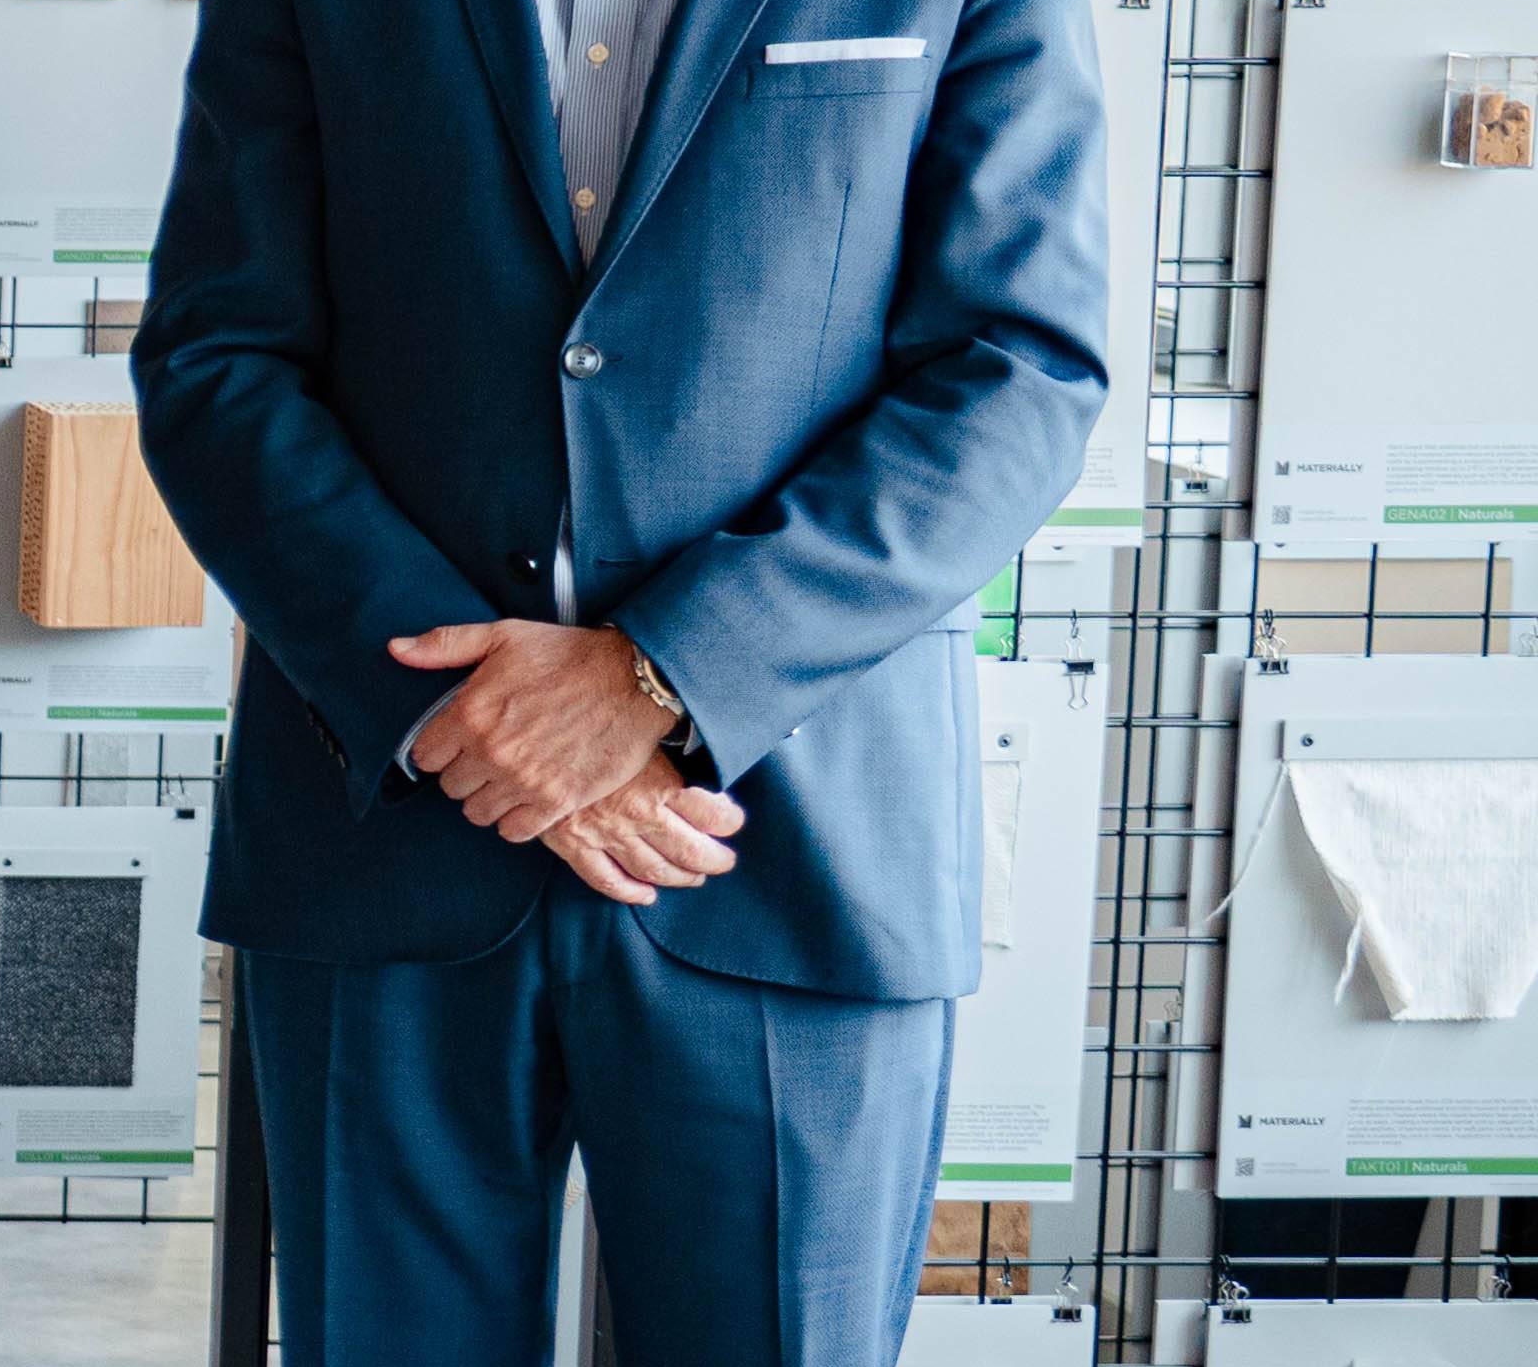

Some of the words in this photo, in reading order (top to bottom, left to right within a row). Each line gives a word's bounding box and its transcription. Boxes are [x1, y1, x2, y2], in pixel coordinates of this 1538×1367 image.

[1297, 463, 1363, 473] MATERIALLY
[1387, 508, 1446, 520] GENA02
[1458, 508, 1514, 520] Naturals
[1259, 1117, 1325, 1126] MATERIALLY
[1412, 1160, 1467, 1171] Naturals
